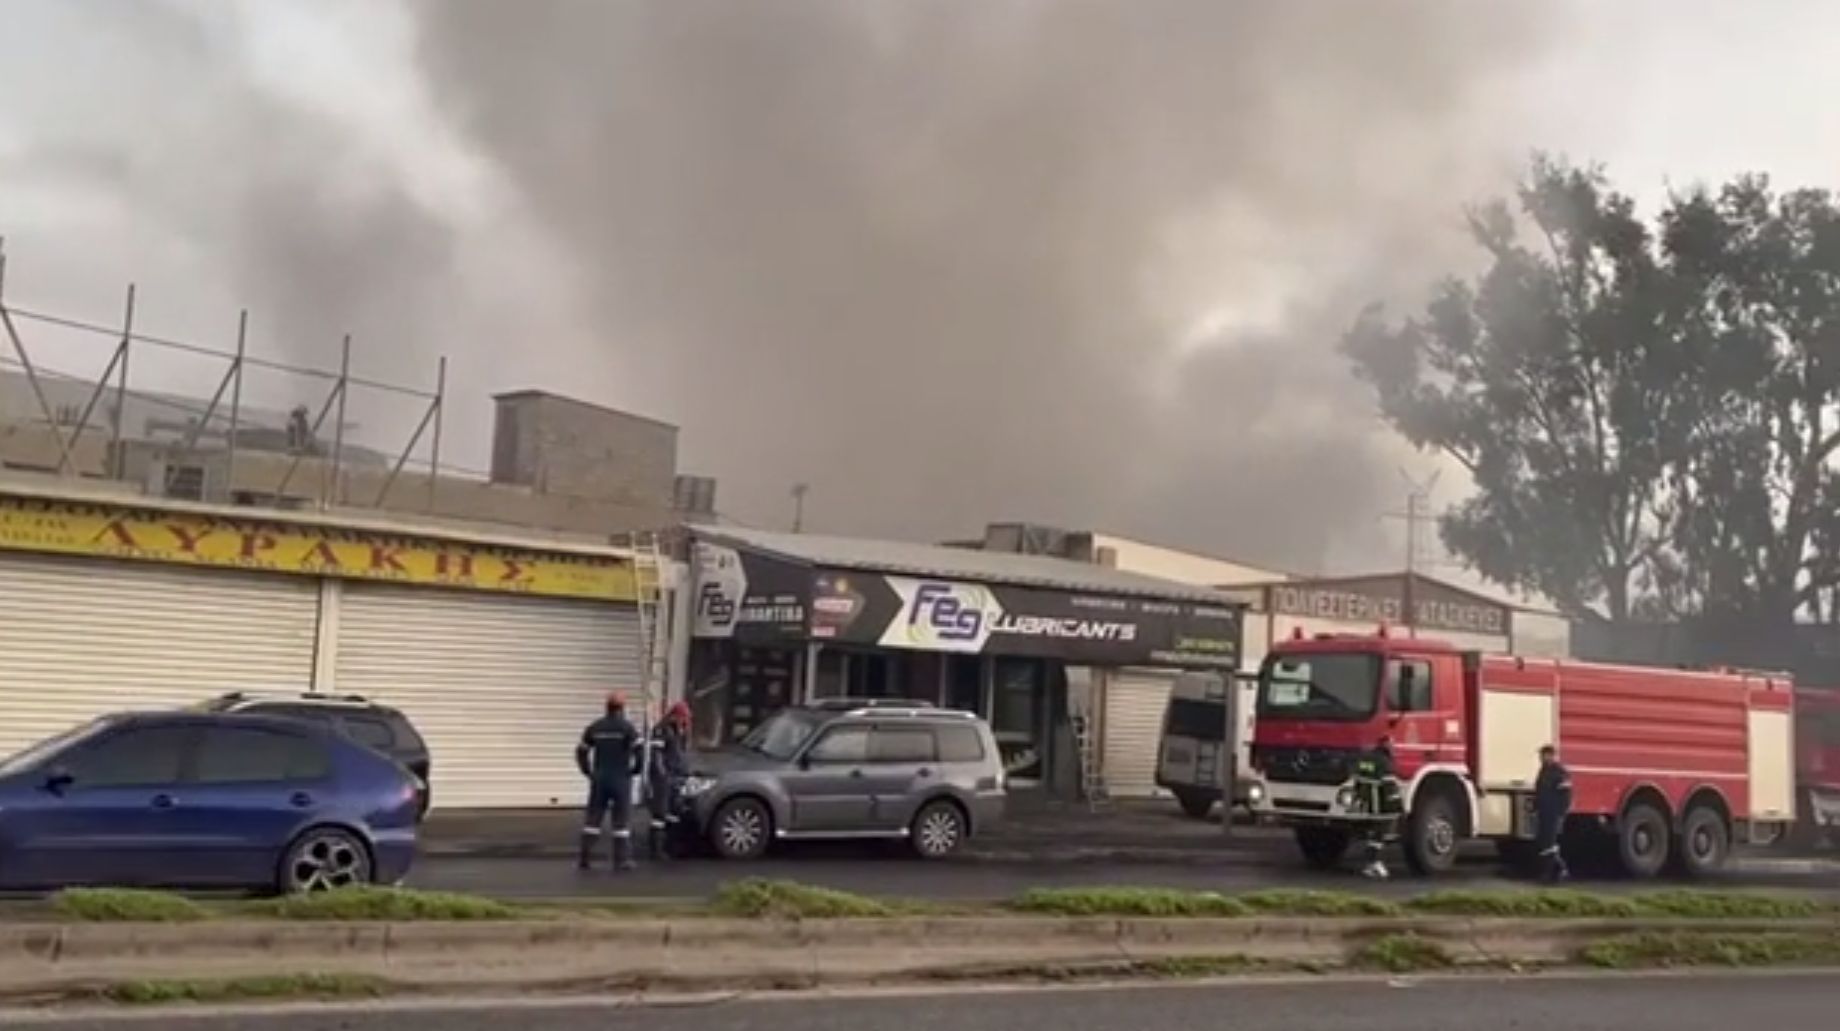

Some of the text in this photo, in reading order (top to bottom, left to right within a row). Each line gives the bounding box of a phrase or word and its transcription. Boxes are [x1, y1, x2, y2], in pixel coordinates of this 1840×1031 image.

[89, 518, 537, 584] ΛΥΡΑΚΗΣ
[908, 583, 1138, 642] Feg LUBRICANTS
